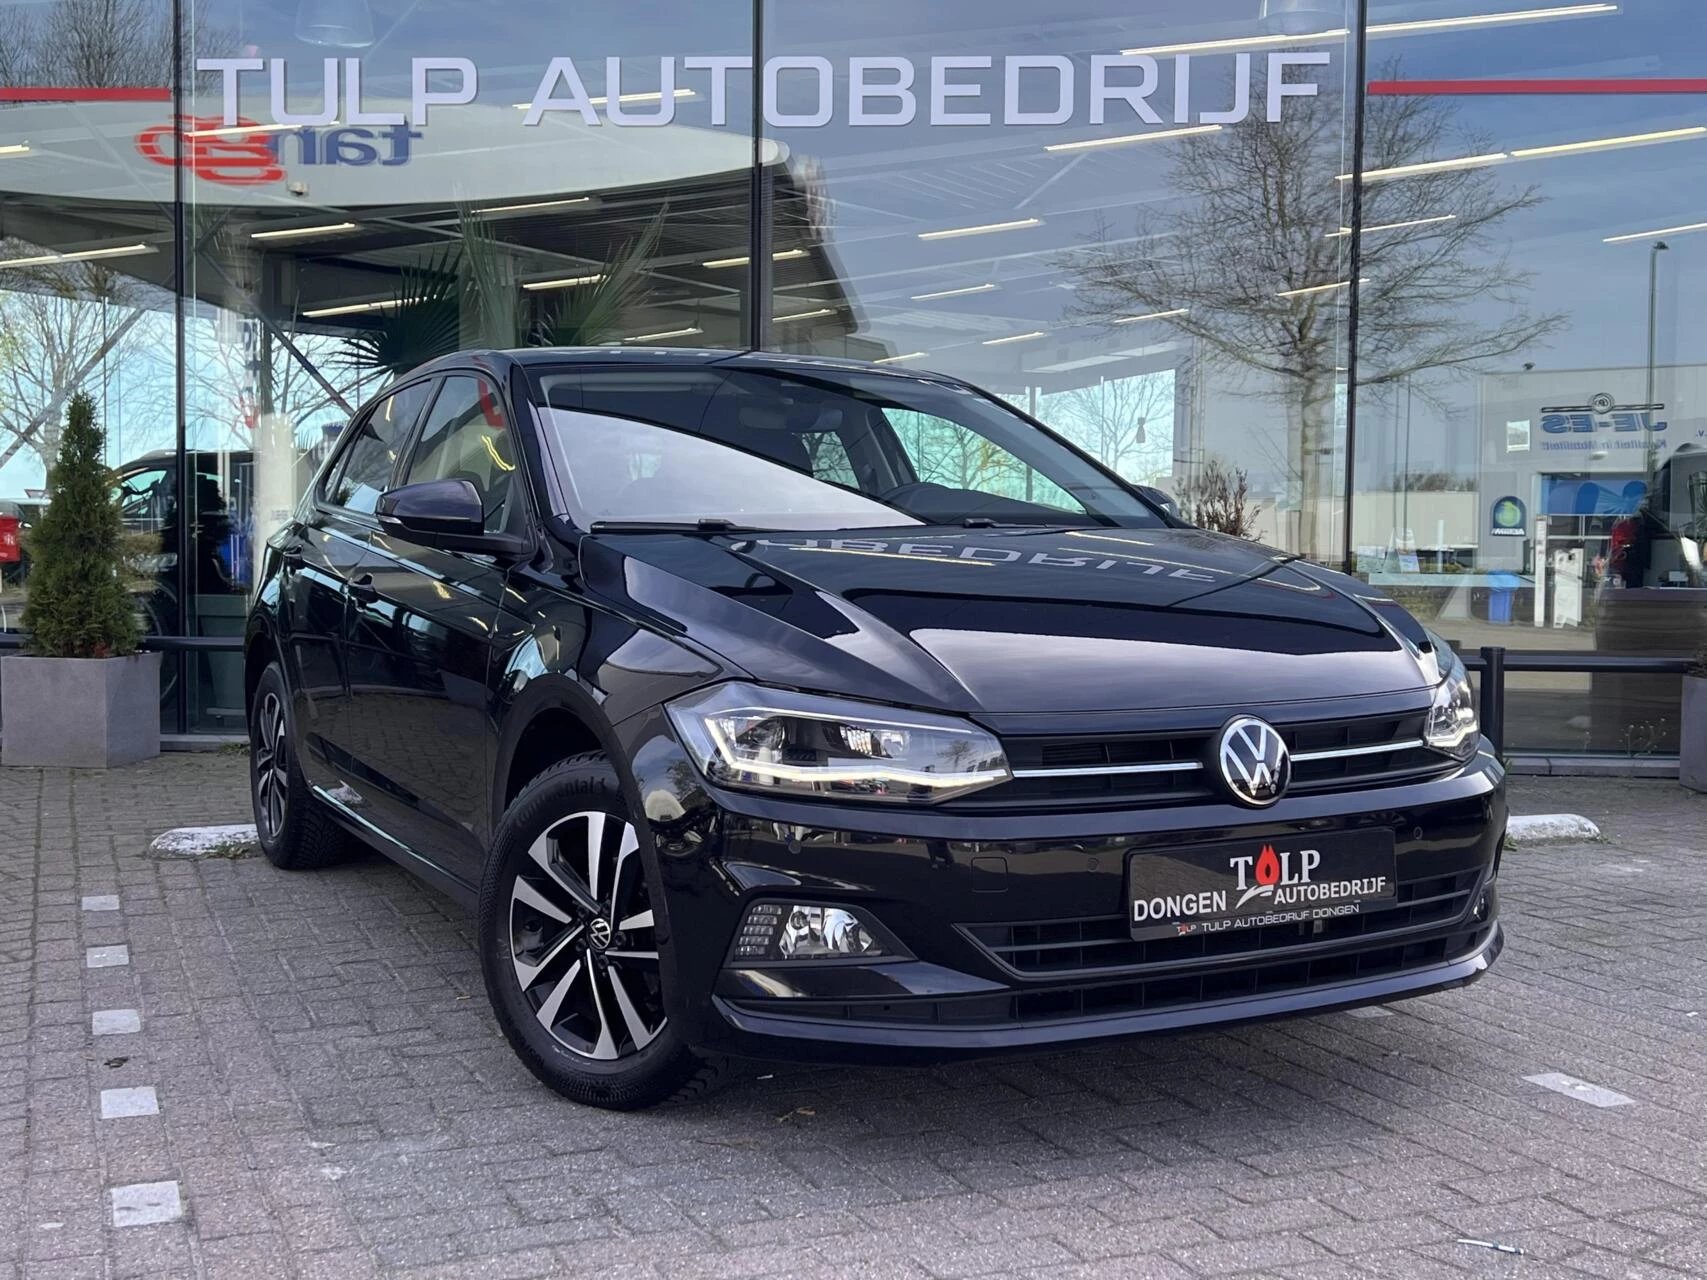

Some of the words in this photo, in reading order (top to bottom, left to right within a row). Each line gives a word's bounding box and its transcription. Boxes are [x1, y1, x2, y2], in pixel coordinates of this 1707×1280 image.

[196, 56, 479, 128] TULP
[522, 51, 1331, 128] AUTOBEDRIJF
[1274, 876, 1387, 905] AUTOBEDRIJF
[1133, 890, 1227, 922] DONGEN
[1202, 920, 1231, 932] TULP
[1234, 910, 1310, 929] AUTOBEDRIJF
[1312, 904, 1360, 918] DONGEN
